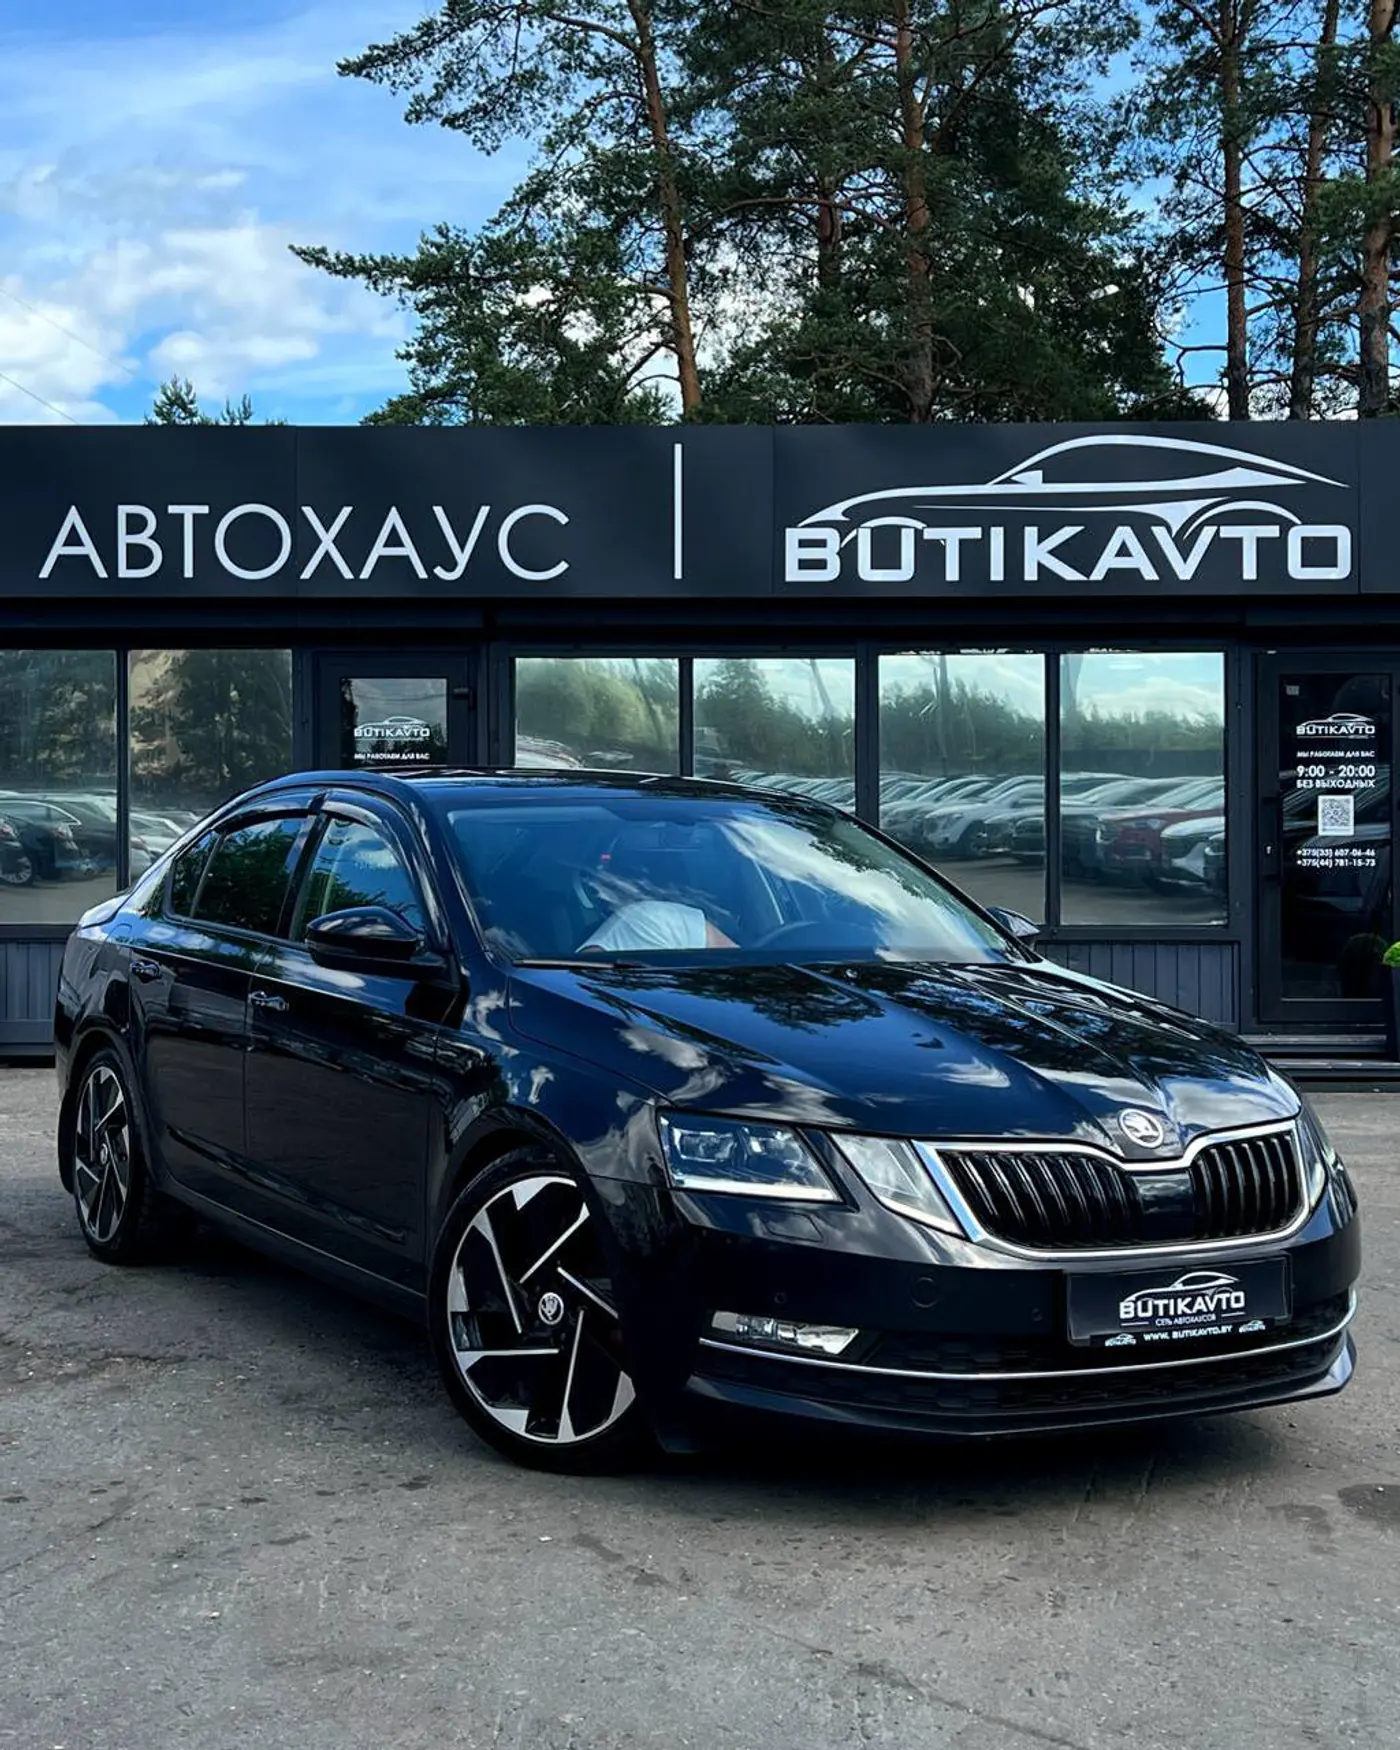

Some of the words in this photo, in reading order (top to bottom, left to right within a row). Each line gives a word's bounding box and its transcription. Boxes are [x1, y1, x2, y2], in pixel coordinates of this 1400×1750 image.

[38, 503, 571, 581] АВТОХАУС
[784, 524, 1352, 583] BUTIKAVTO
[354, 727, 430, 737] BUTIKAVTO
[1296, 725, 1375, 735] BUTIKAVTO
[1297, 765, 1325, 777] 9:00
[1339, 765, 1375, 777] 20:00
[1297, 780, 1314, 788] БЕЗ
[1315, 780, 1376, 789] ВЫХОДНЫХ
[1119, 1291, 1246, 1319] BUTIKAVTO
